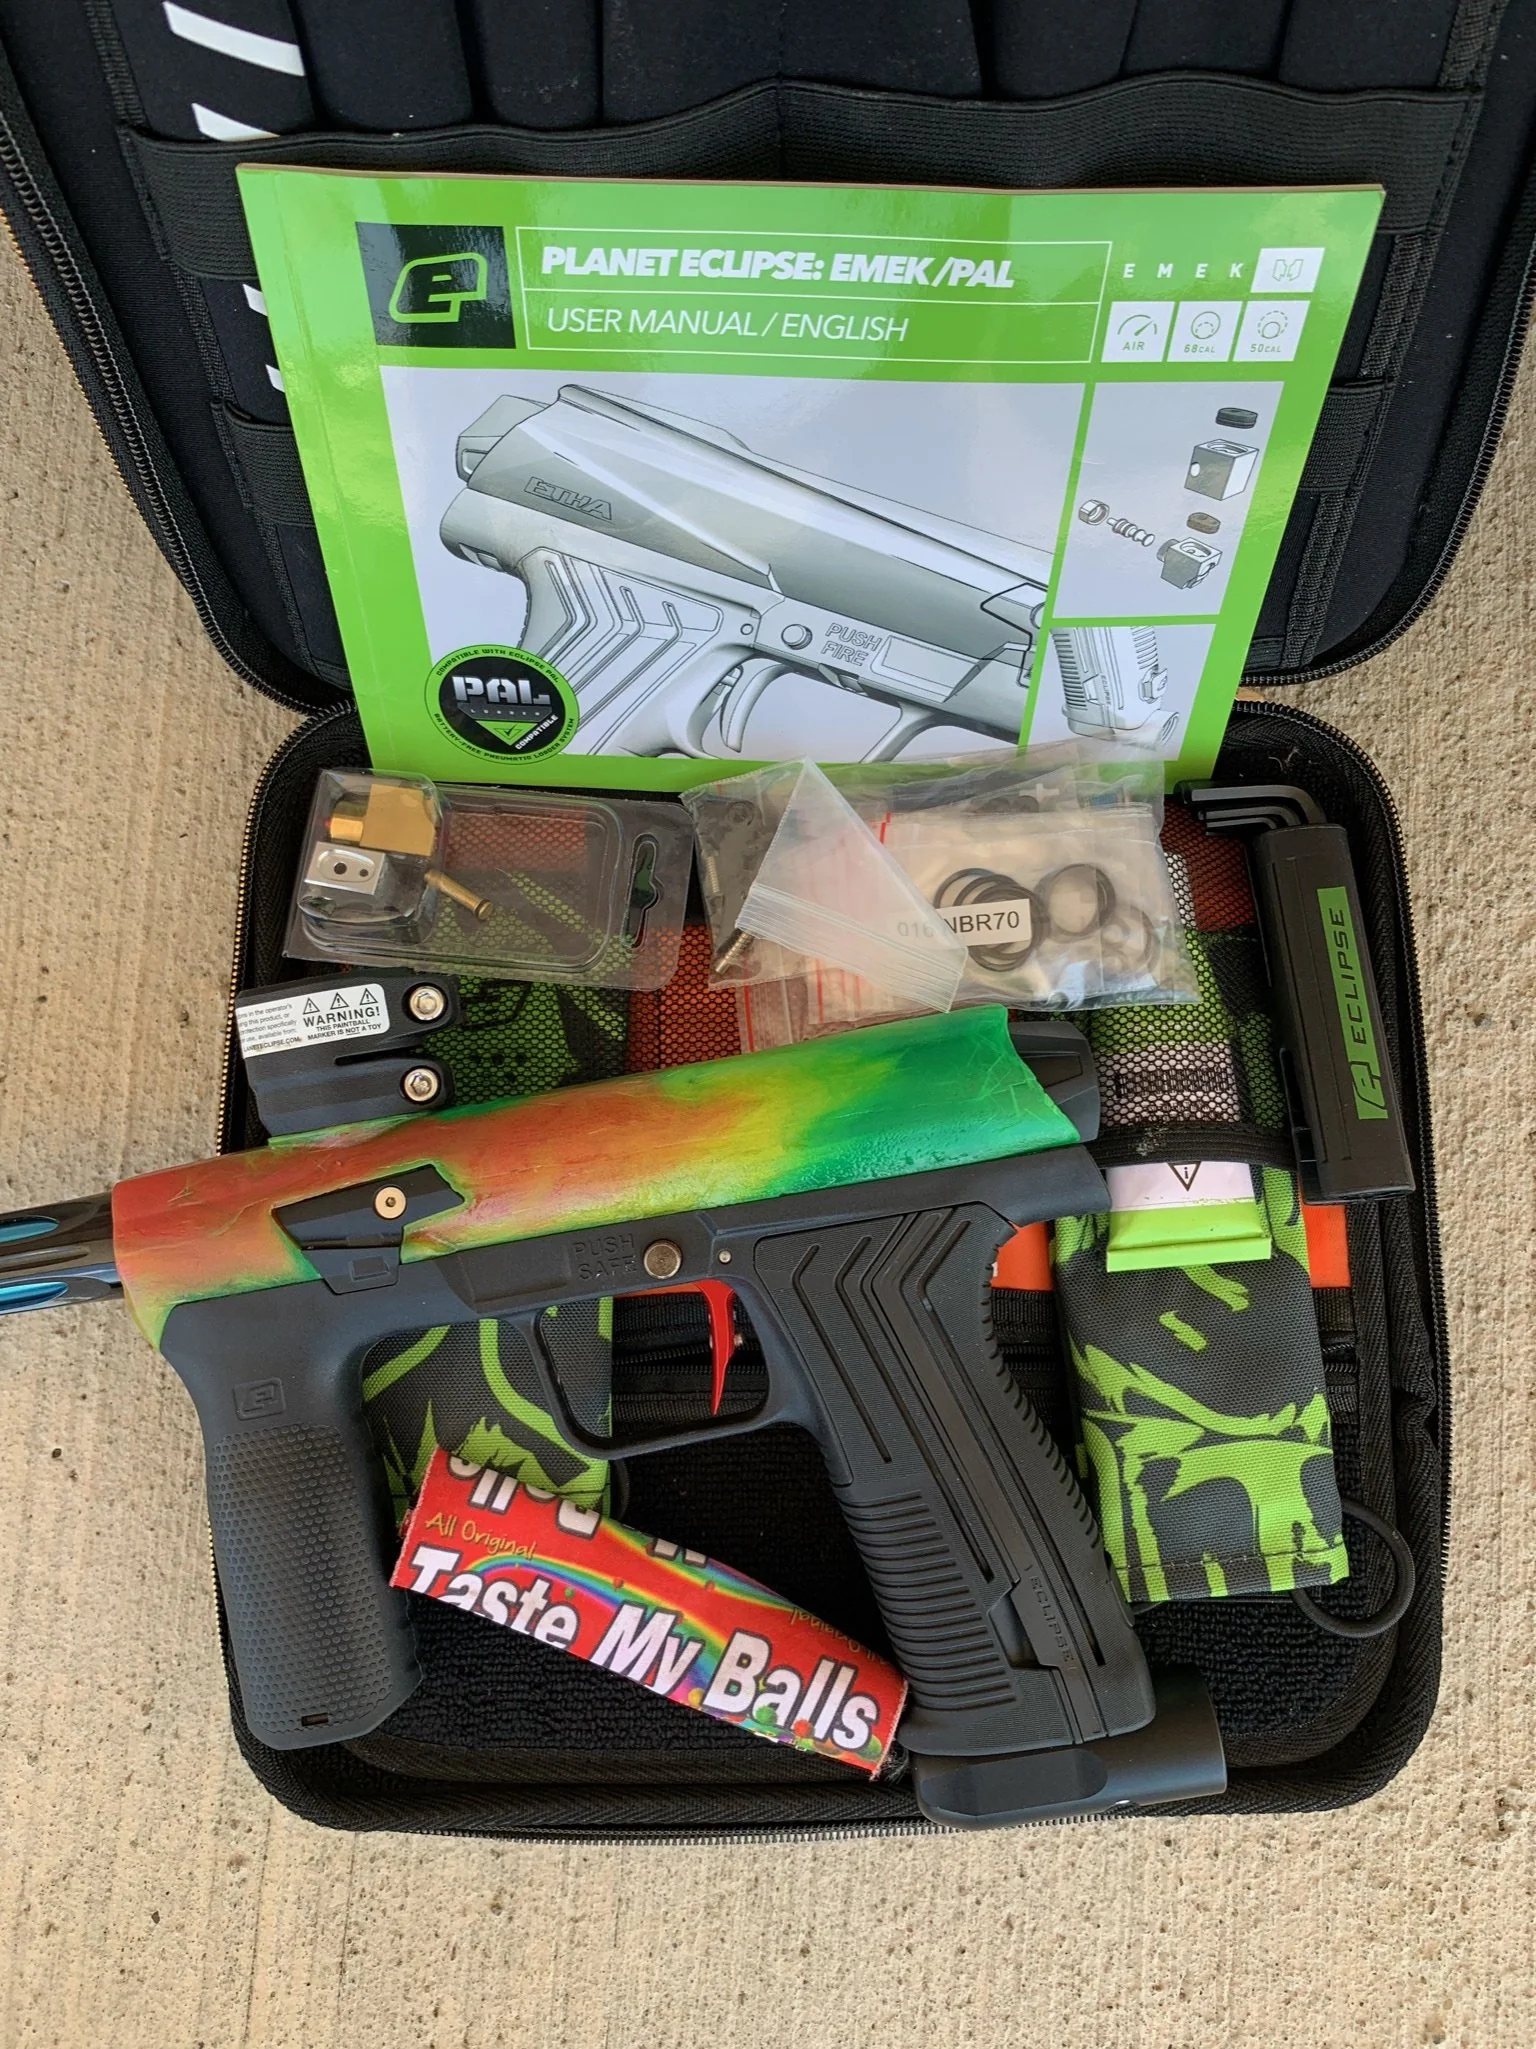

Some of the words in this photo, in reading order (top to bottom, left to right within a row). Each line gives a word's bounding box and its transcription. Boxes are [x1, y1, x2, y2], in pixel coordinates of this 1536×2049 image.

[542, 246, 678, 277] PLANET
[679, 249, 825, 281] ECLIPSE:
[829, 253, 1015, 288] EMEK/PAL
[547, 307, 623, 333] USER
[628, 309, 758, 337] MANUAL
[780, 313, 909, 342] ENGLISH
[1122, 341, 1145, 351] AIR
[1183, 344, 1215, 354] 68CAL
[1249, 343, 1281, 353] 50CAL
[524, 476, 612, 520] ETHA
[825, 622, 882, 652] PUSH
[436, 649, 478, 677] COMPATIBLE
[509, 651, 545, 670] ECLIPSE
[546, 669, 559, 683] PAL
[820, 641, 869, 667] FIRE
[452, 676, 550, 705] PAL
[514, 714, 559, 750] COMPATIBLE
[944, 910, 1020, 934] NBR70
[1328, 907, 1367, 1045] ECLIPSE
[303, 1006, 381, 1028] WARNING!
[316, 1024, 332, 1032] THIS
[333, 1019, 370, 1030] PAINTBALL
[307, 1031, 336, 1041] MARKER
[346, 1026, 360, 1035] NOT
[368, 1023, 382, 1031] TOY
[573, 1232, 634, 1256] PUSH
[579, 1254, 638, 1280] SAFE
[426, 1512, 456, 1538] All
[461, 1521, 536, 1561] Original
[1030, 1576, 1074, 1663] ECLIPSE
[407, 1543, 578, 1651] Taste
[589, 1601, 702, 1696] My
[703, 1630, 880, 1752] Balls
